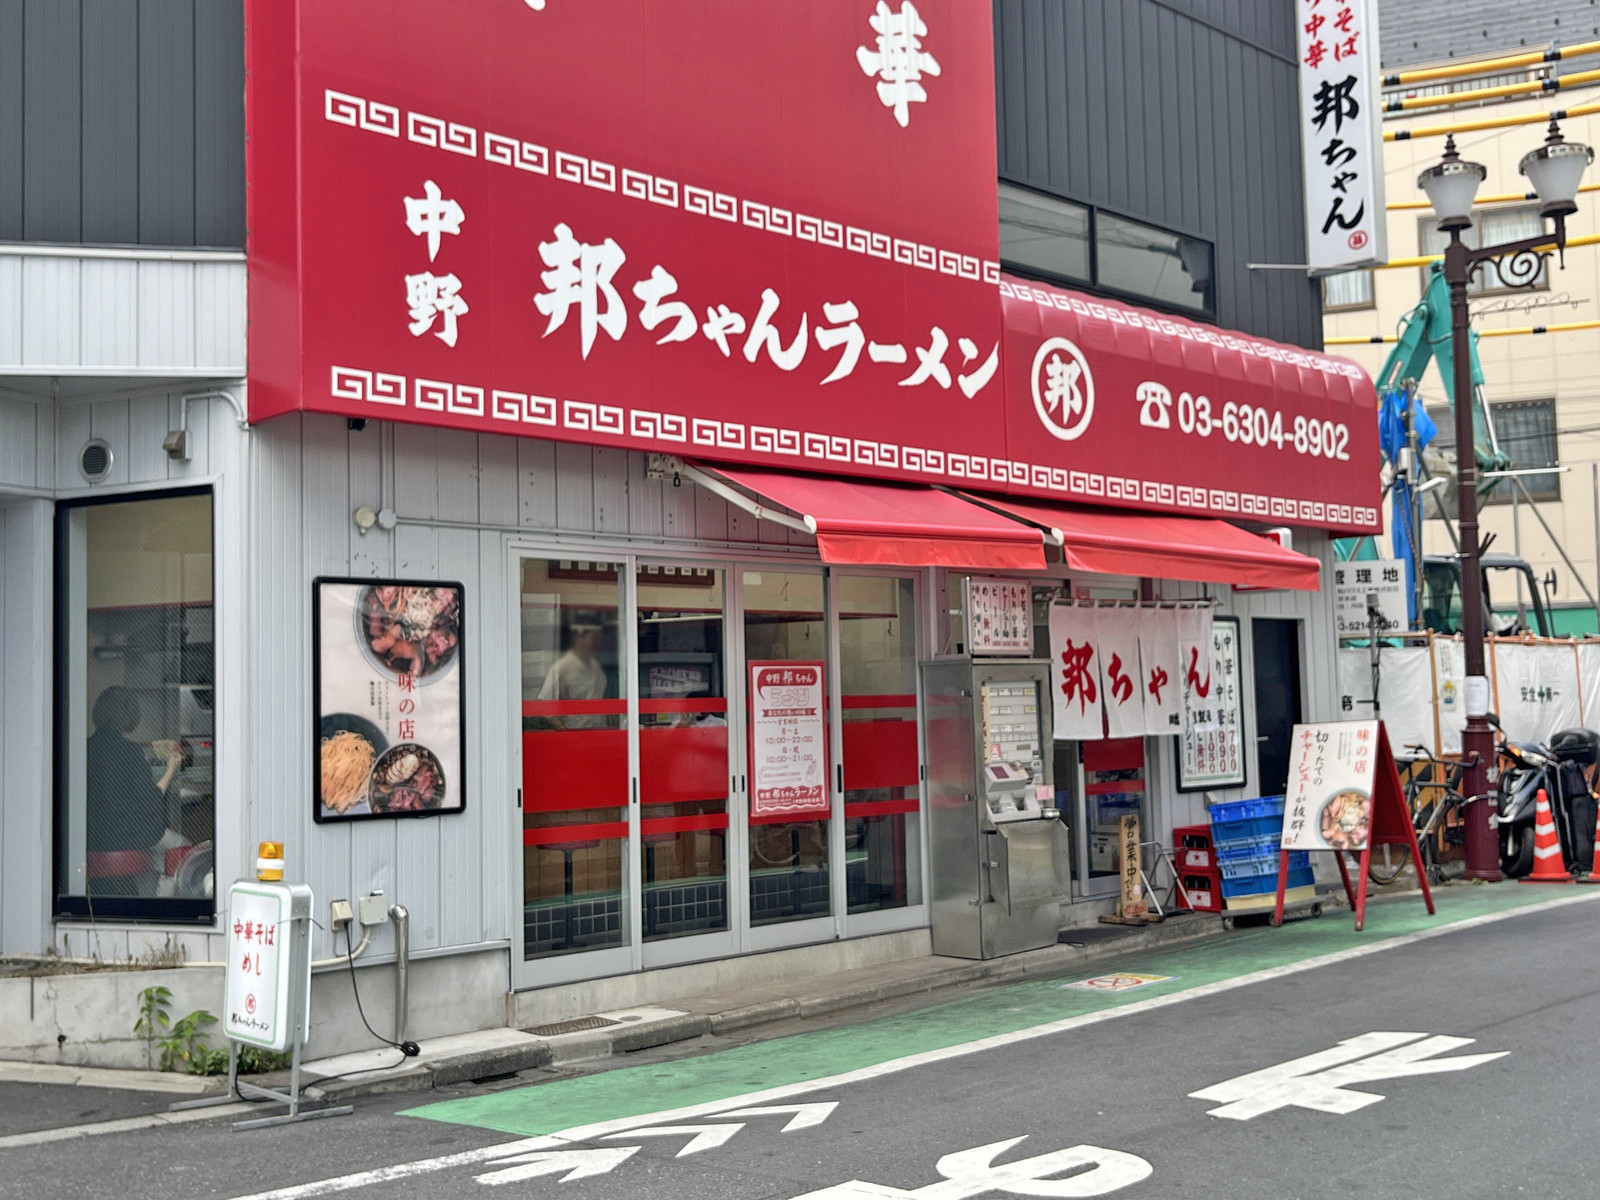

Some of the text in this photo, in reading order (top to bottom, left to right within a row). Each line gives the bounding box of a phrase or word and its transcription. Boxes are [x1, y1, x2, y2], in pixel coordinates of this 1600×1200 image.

[1333, 0, 1361, 62] そば
[1310, 75, 1365, 235] 邦ちゃん
[402, 180, 470, 348] 中野
[533, 222, 1000, 398] 邦ちゃんラーメン
[1177, 391, 1351, 461] 03-6304-8902
[398, 671, 416, 740] 味の店
[1061, 638, 1210, 717] 邦ちゃん
[1213, 634, 1226, 773] もり中華 990
[1223, 633, 1237, 771] 中華そば 790
[1312, 730, 1329, 785] 切りたての
[1354, 730, 1370, 775] 味の店
[233, 918, 275, 946] 中華そば
[242, 952, 262, 976] めし
